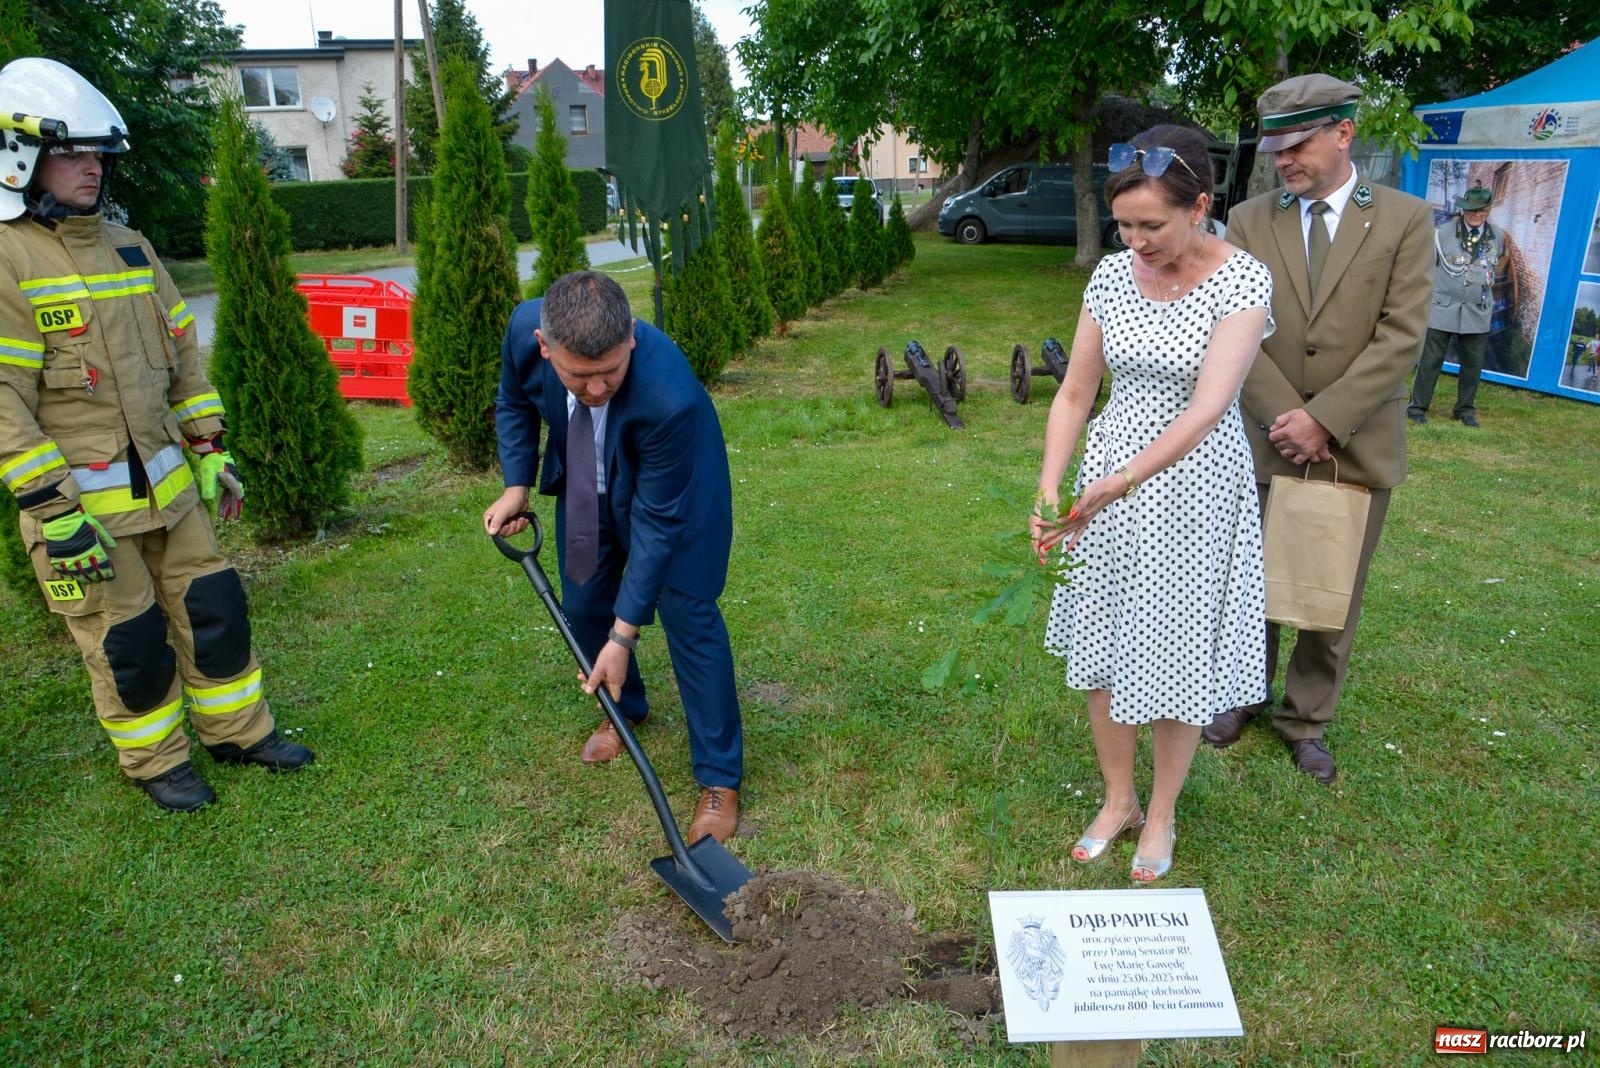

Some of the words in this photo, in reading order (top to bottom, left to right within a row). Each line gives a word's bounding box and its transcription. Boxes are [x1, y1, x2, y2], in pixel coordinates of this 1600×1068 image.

[40, 309, 74, 327] OSP
[50, 583, 75, 597] OSP
[1082, 934, 1132, 945] uroczyście
[1134, 933, 1186, 945] posadzony
[1082, 949, 1108, 959] przez
[1110, 946, 1137, 958] Panią
[1138, 946, 1175, 956] Senator
[1094, 960, 1113, 972] Ewę
[1116, 959, 1144, 971] Marię
[1098, 974, 1119, 983] dniu
[1176, 971, 1199, 981] roku
[1104, 987, 1149, 999] pamiątkę
[1151, 985, 1201, 996] obchodów
[1074, 1001, 1125, 1014] jubileuszu
[1179, 1000, 1224, 1009] Gamowa
